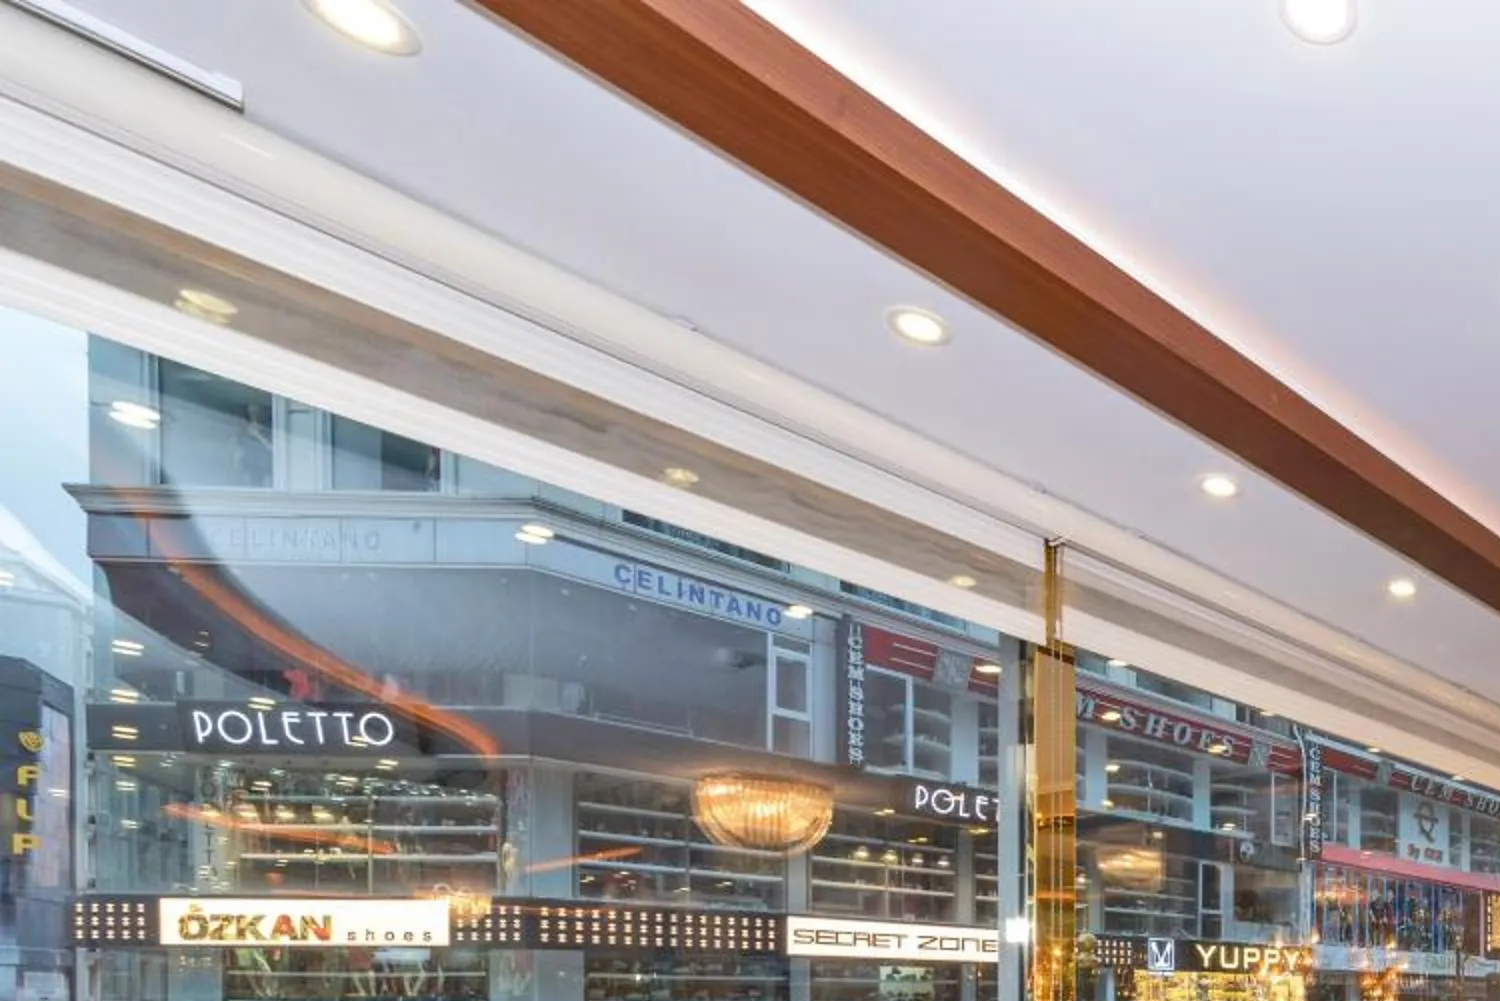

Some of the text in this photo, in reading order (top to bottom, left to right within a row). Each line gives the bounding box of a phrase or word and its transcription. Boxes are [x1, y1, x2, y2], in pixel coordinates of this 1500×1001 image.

[192, 710, 394, 746] POLETTO
[178, 903, 433, 942] ÖZKAN shoes
[793, 927, 908, 949] SECRET
[1195, 943, 1301, 970] YUPPY
